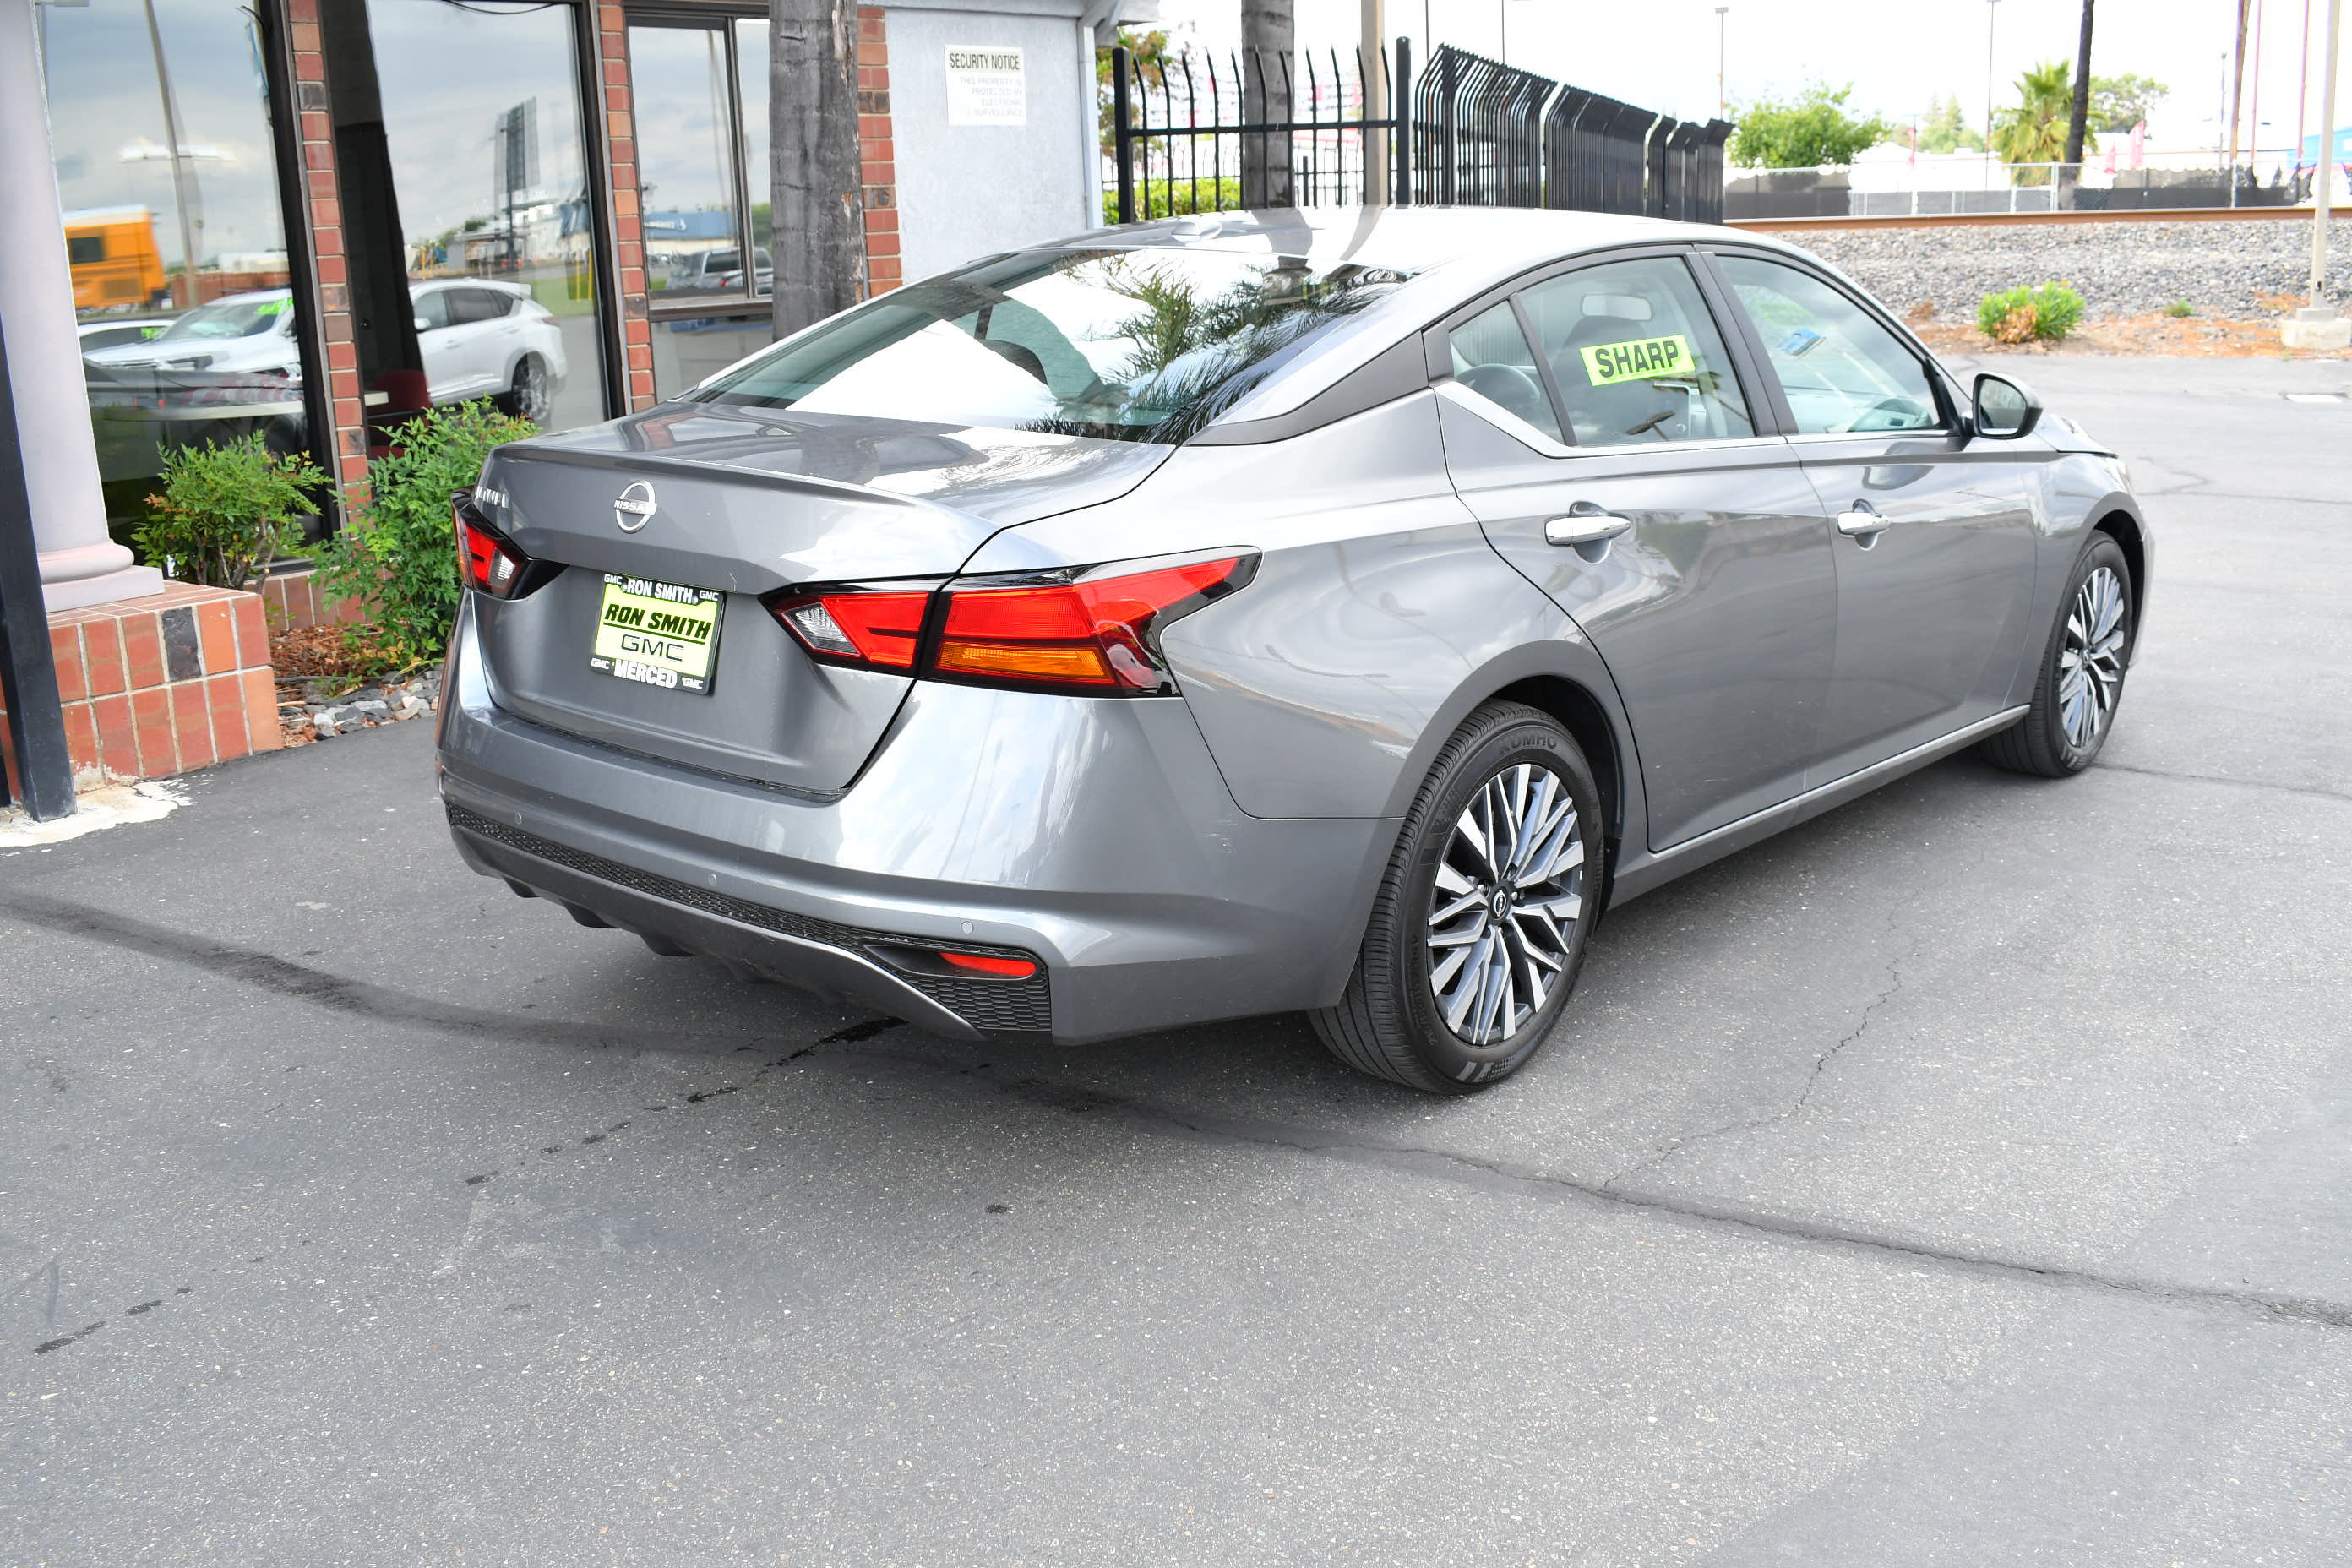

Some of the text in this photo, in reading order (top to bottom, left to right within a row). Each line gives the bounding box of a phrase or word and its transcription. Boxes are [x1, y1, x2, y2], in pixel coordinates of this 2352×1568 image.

[950, 52, 1020, 70] SECURITY NOTICE
[960, 76, 976, 85] THIS
[972, 87, 1012, 95] PROTECTED
[1595, 340, 1679, 378] SHARP
[614, 499, 655, 514] NISSA
[604, 574, 718, 604] GMC RON SMITH GMC
[605, 603, 712, 640] RON SMITH
[621, 634, 684, 662] GMC
[591, 657, 703, 690] GMC MERCED GMC
[1500, 734, 1557, 755] KUMHO
